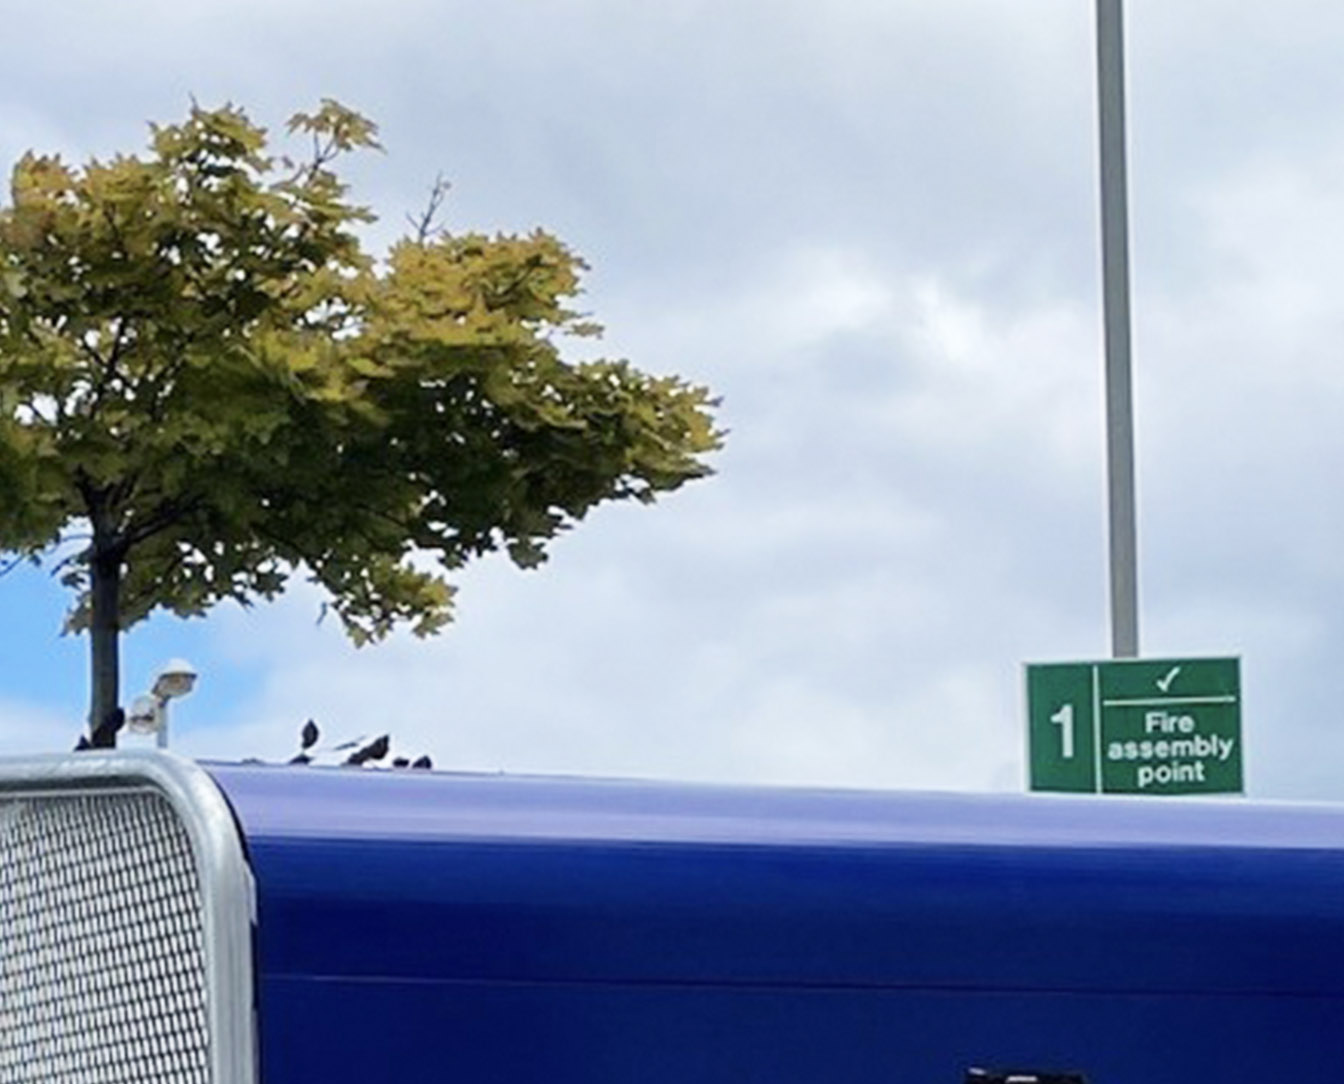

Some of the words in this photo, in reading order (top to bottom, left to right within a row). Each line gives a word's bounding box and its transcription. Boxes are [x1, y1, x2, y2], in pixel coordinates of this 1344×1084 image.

[1050, 704, 1074, 758] 1
[1144, 711, 1196, 734] Fire
[1107, 734, 1234, 761] assembly
[1137, 762, 1205, 788] point
